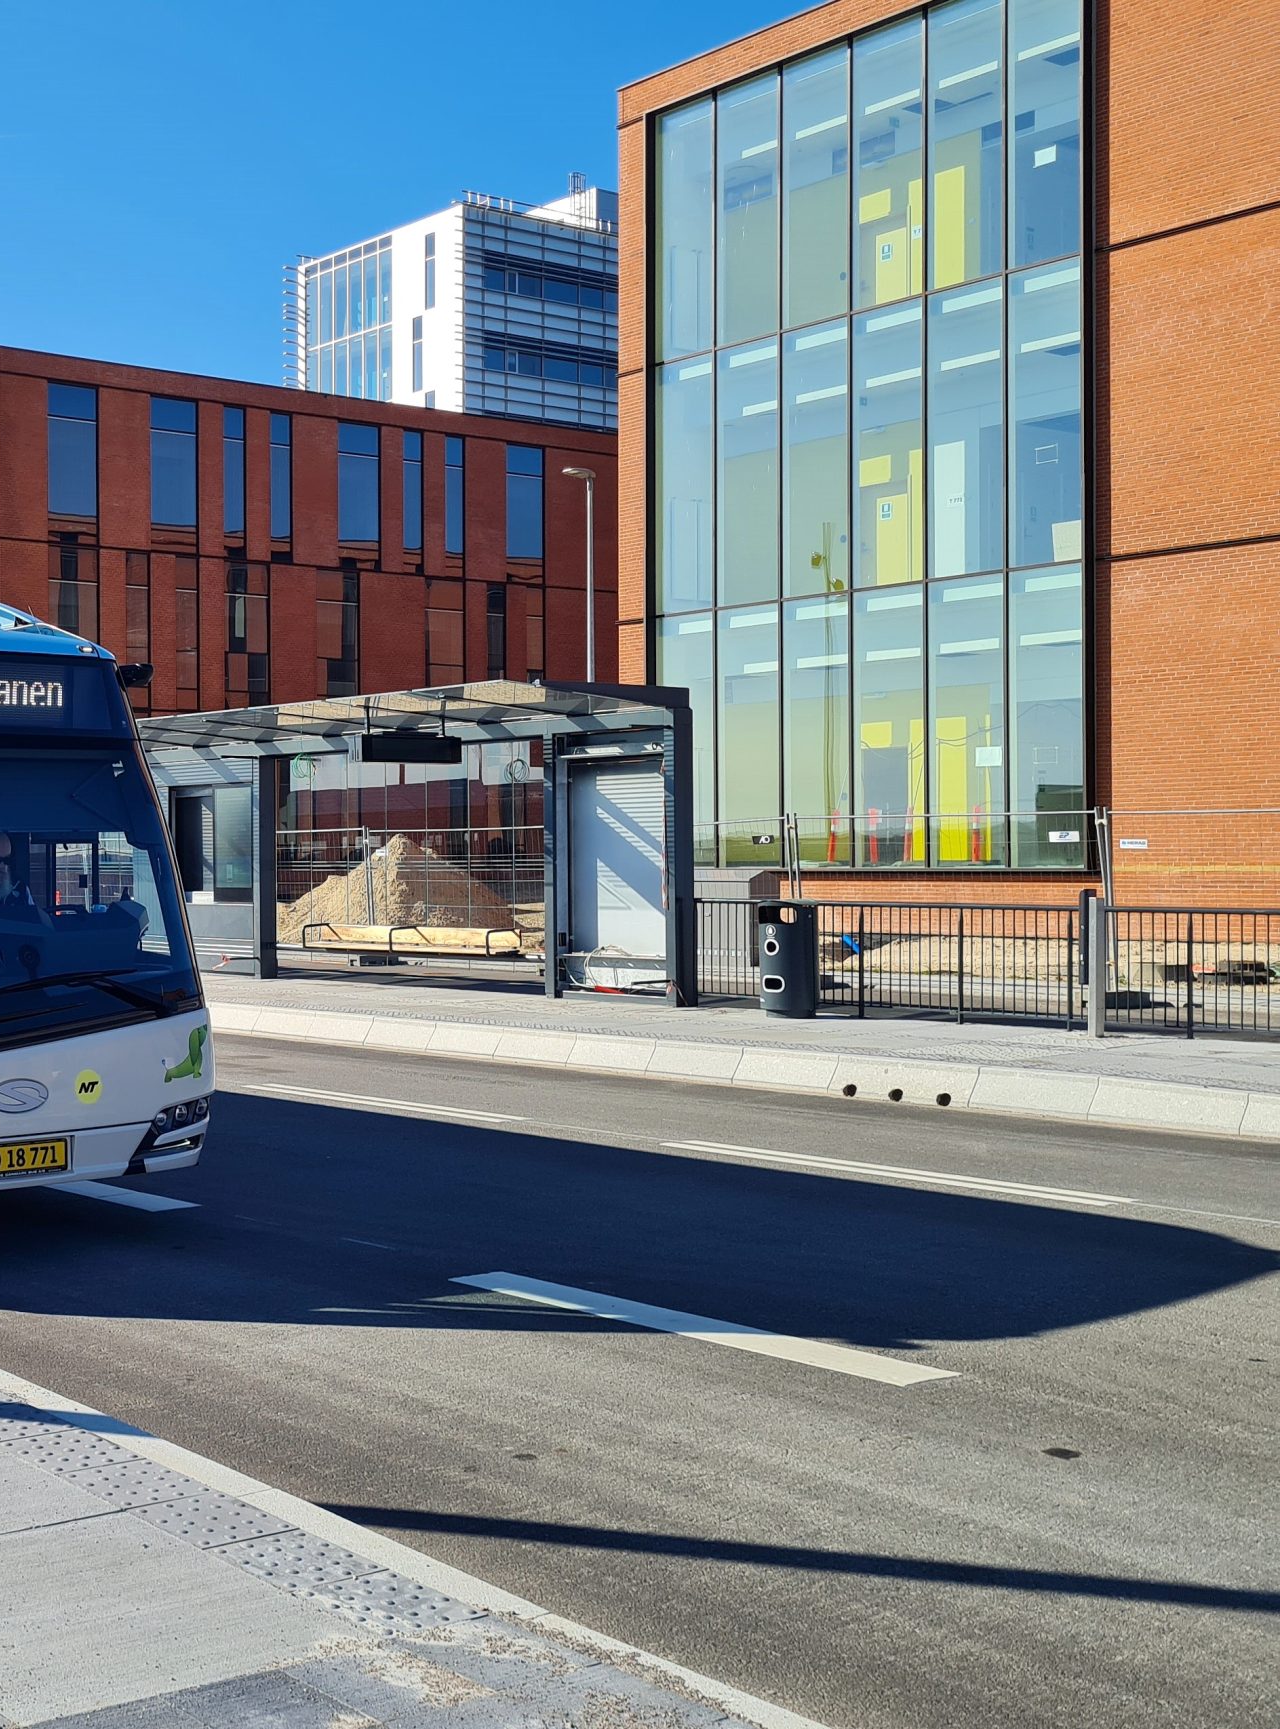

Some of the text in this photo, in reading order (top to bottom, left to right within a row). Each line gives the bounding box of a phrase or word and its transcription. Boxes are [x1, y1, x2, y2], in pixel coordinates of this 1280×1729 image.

[78, 1081, 98, 1094] NT
[7, 1147, 25, 1168] 18
[30, 1145, 58, 1165] 771
